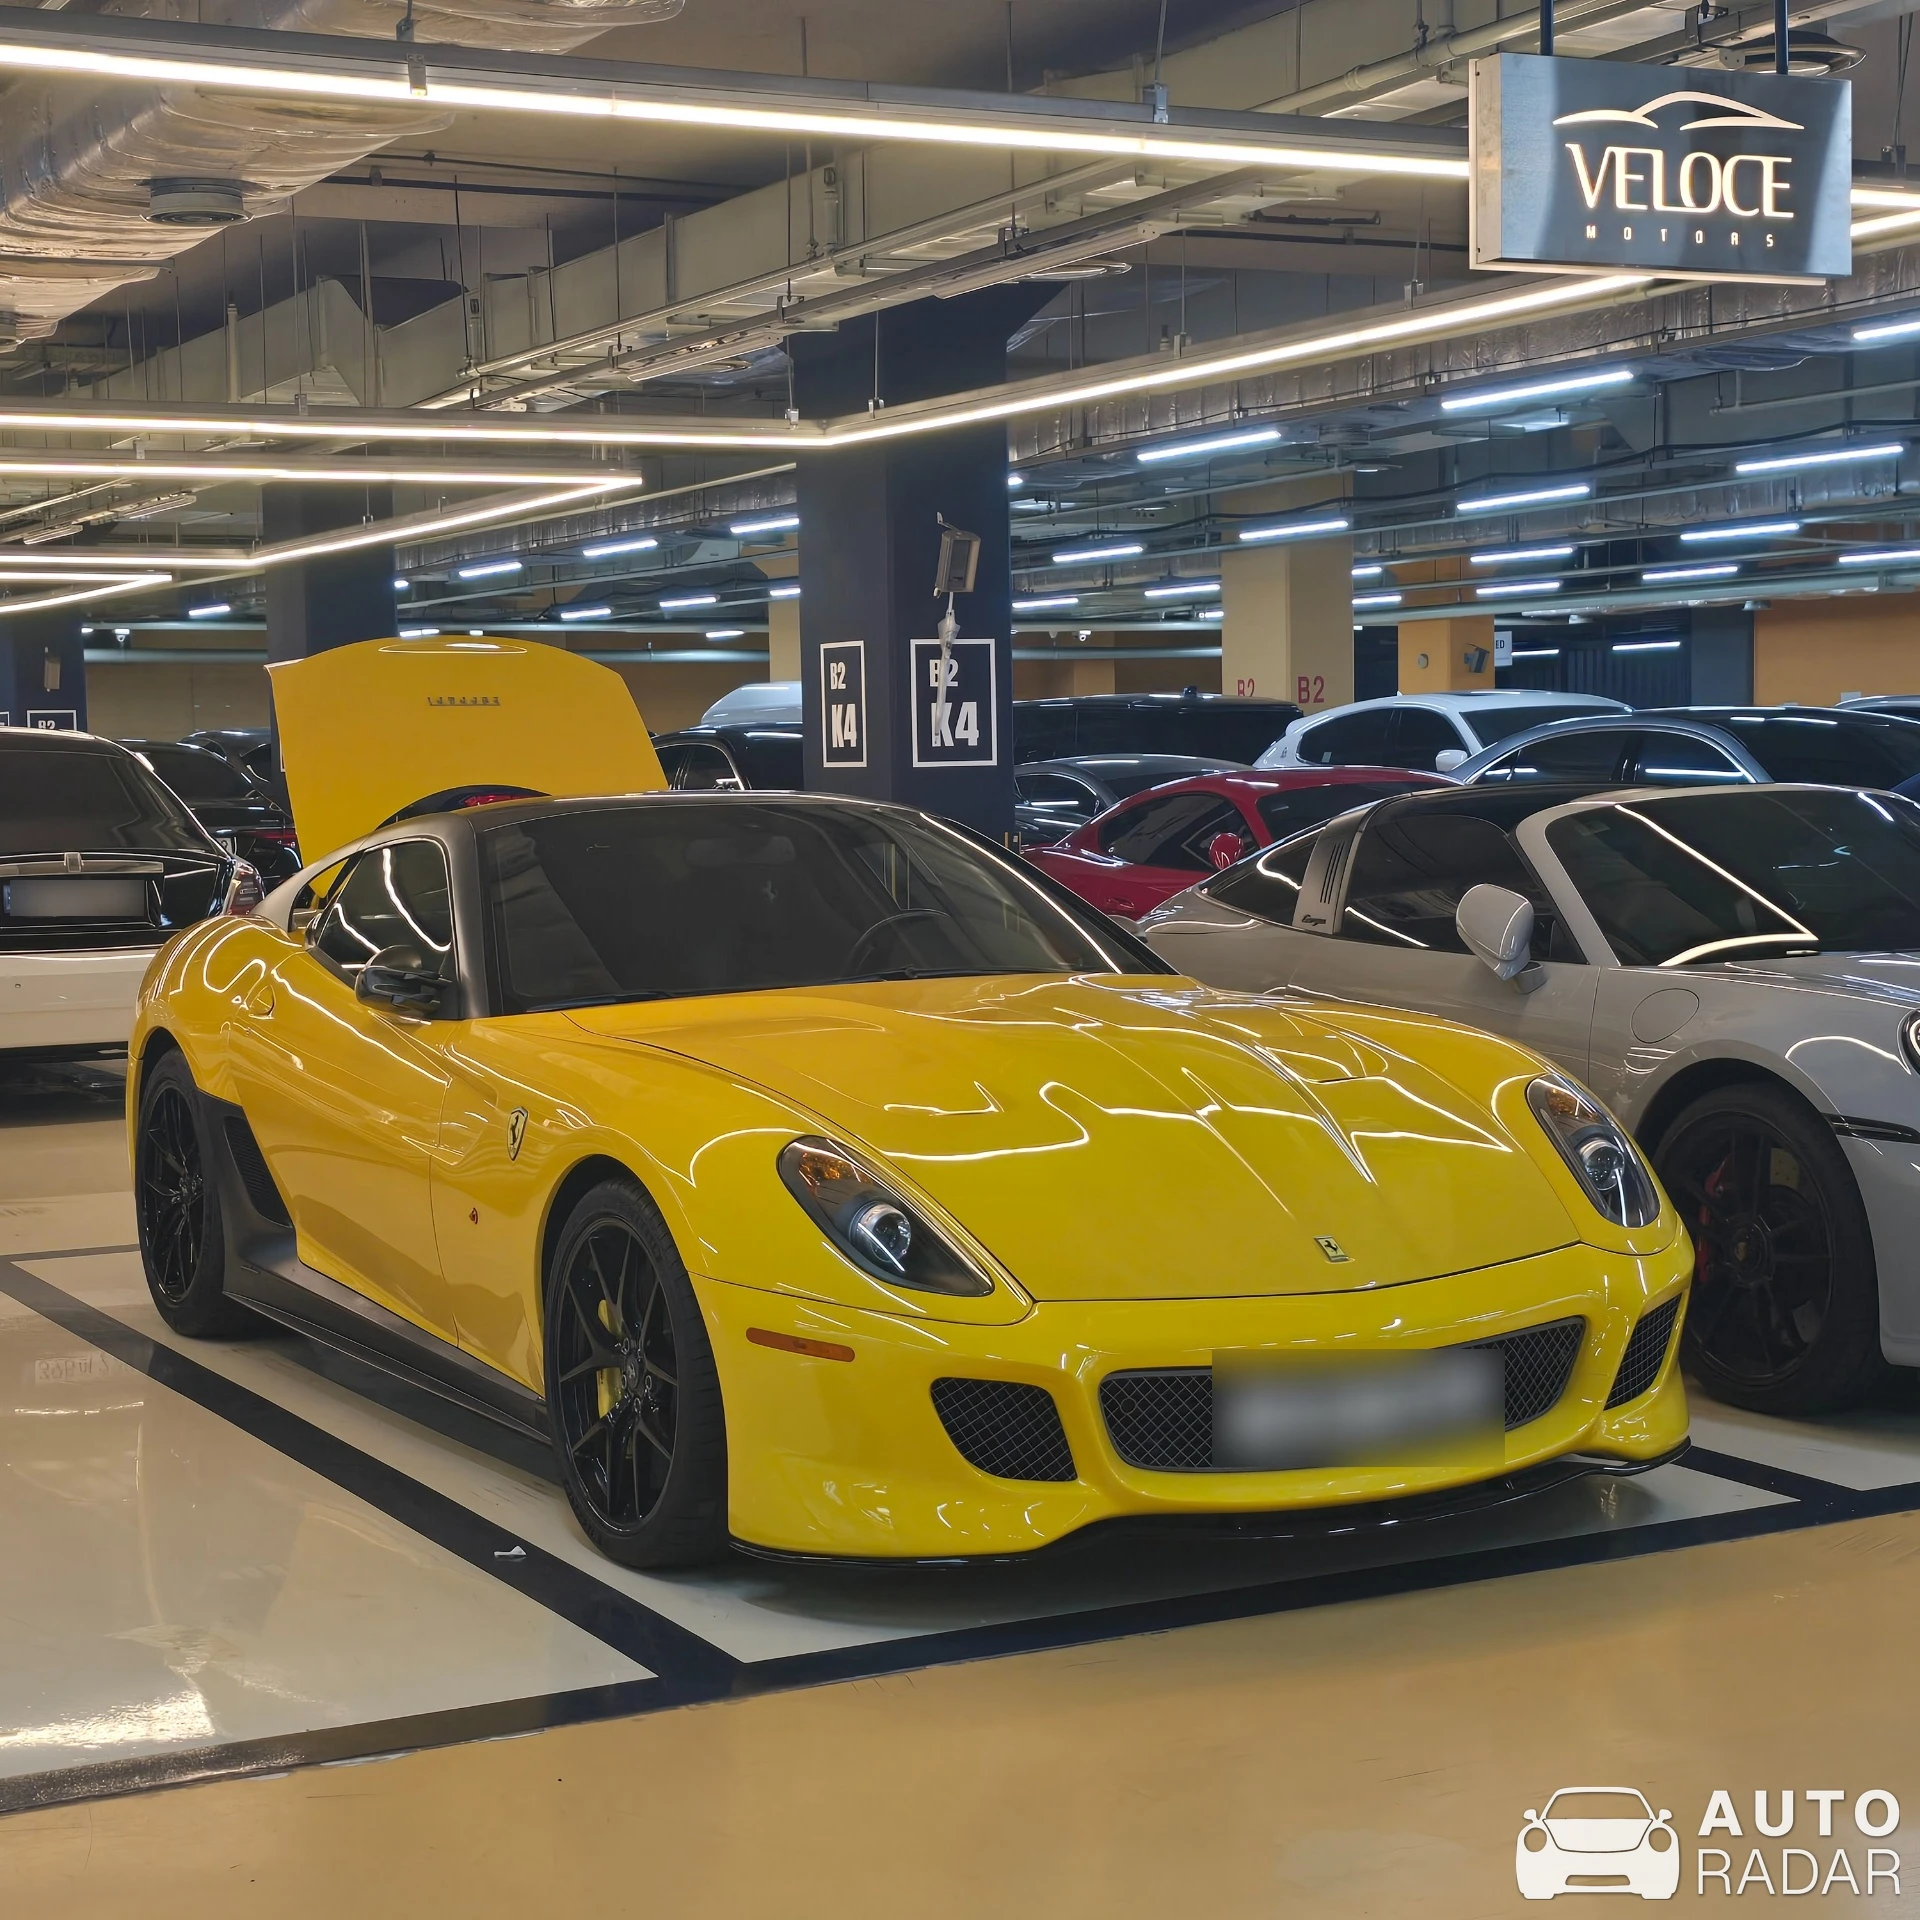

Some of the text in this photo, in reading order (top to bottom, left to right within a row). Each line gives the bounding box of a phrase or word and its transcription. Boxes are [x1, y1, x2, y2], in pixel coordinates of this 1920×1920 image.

[1565, 143, 1794, 218] VELOCE
[1586, 225, 1774, 247] MOTORS
[830, 661, 846, 690] B2
[929, 659, 959, 687] B2
[1297, 675, 1325, 704] B2
[831, 703, 857, 748] K4
[930, 701, 979, 747] K4
